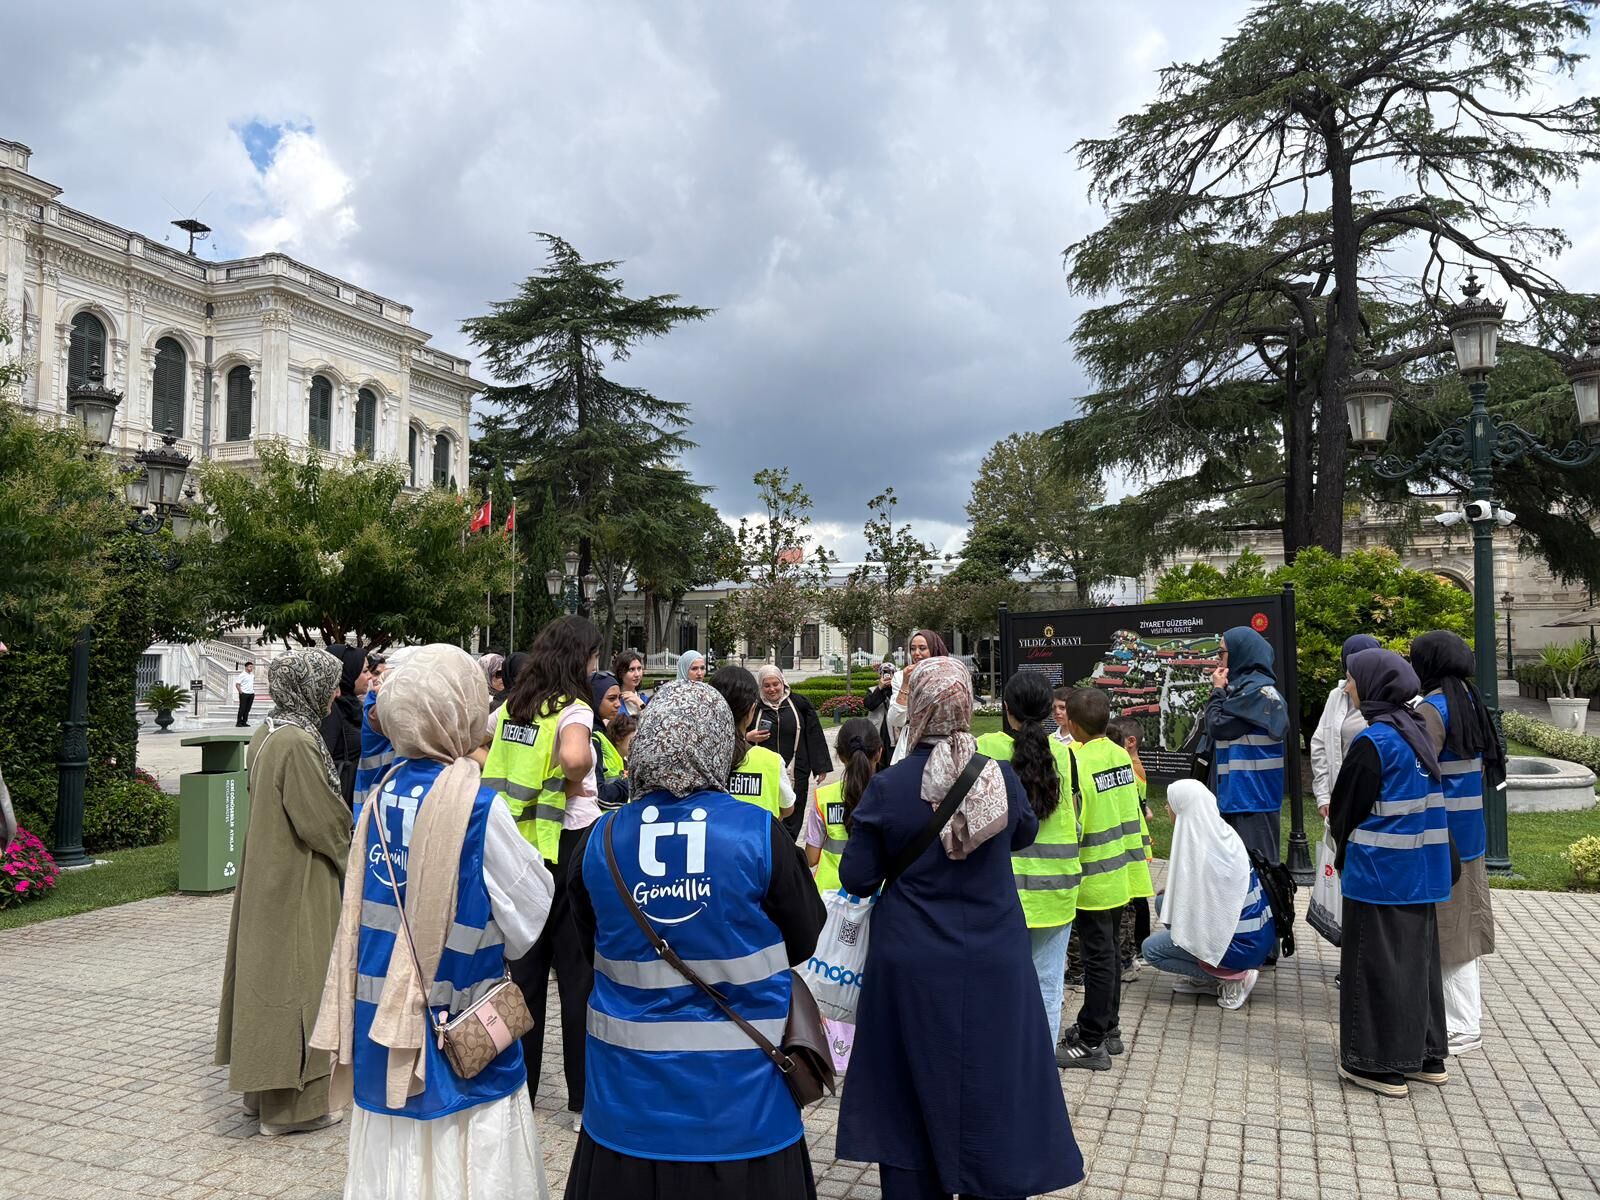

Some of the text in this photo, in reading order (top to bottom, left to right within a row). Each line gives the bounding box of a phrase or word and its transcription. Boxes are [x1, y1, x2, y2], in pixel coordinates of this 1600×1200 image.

[1139, 620, 1166, 629] ZİYARET
[1150, 626, 1193, 635] VISITING ROUTE
[1018, 637, 1081, 648] YILDIZ SARAYI
[730, 773, 760, 795] EĞİTİM
[633, 877, 711, 905] Gönüllü
